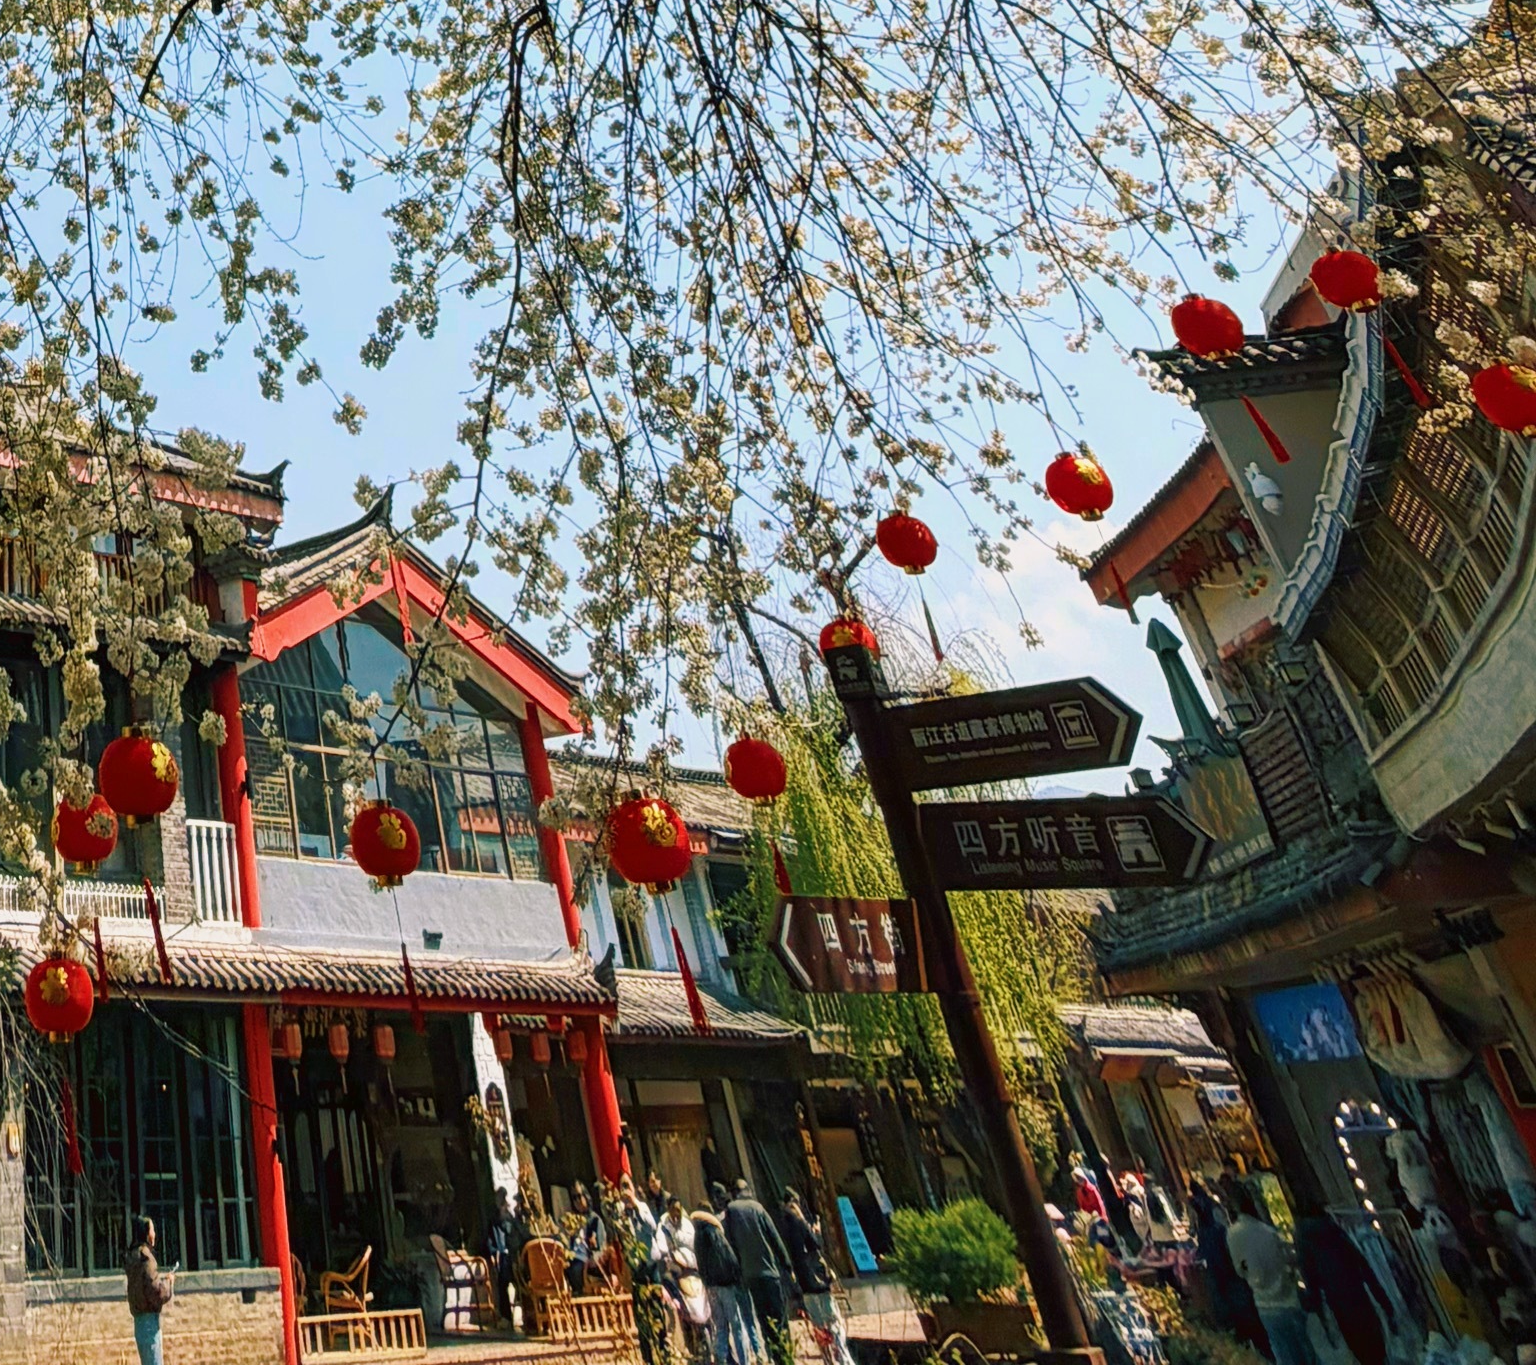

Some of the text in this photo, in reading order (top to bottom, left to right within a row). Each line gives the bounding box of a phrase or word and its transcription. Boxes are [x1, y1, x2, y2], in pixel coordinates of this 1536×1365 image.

[953, 813, 1100, 857] 四方听音
[1024, 857, 1059, 873] Music
[1061, 856, 1105, 872] Square
[816, 912, 905, 955] 四方街
